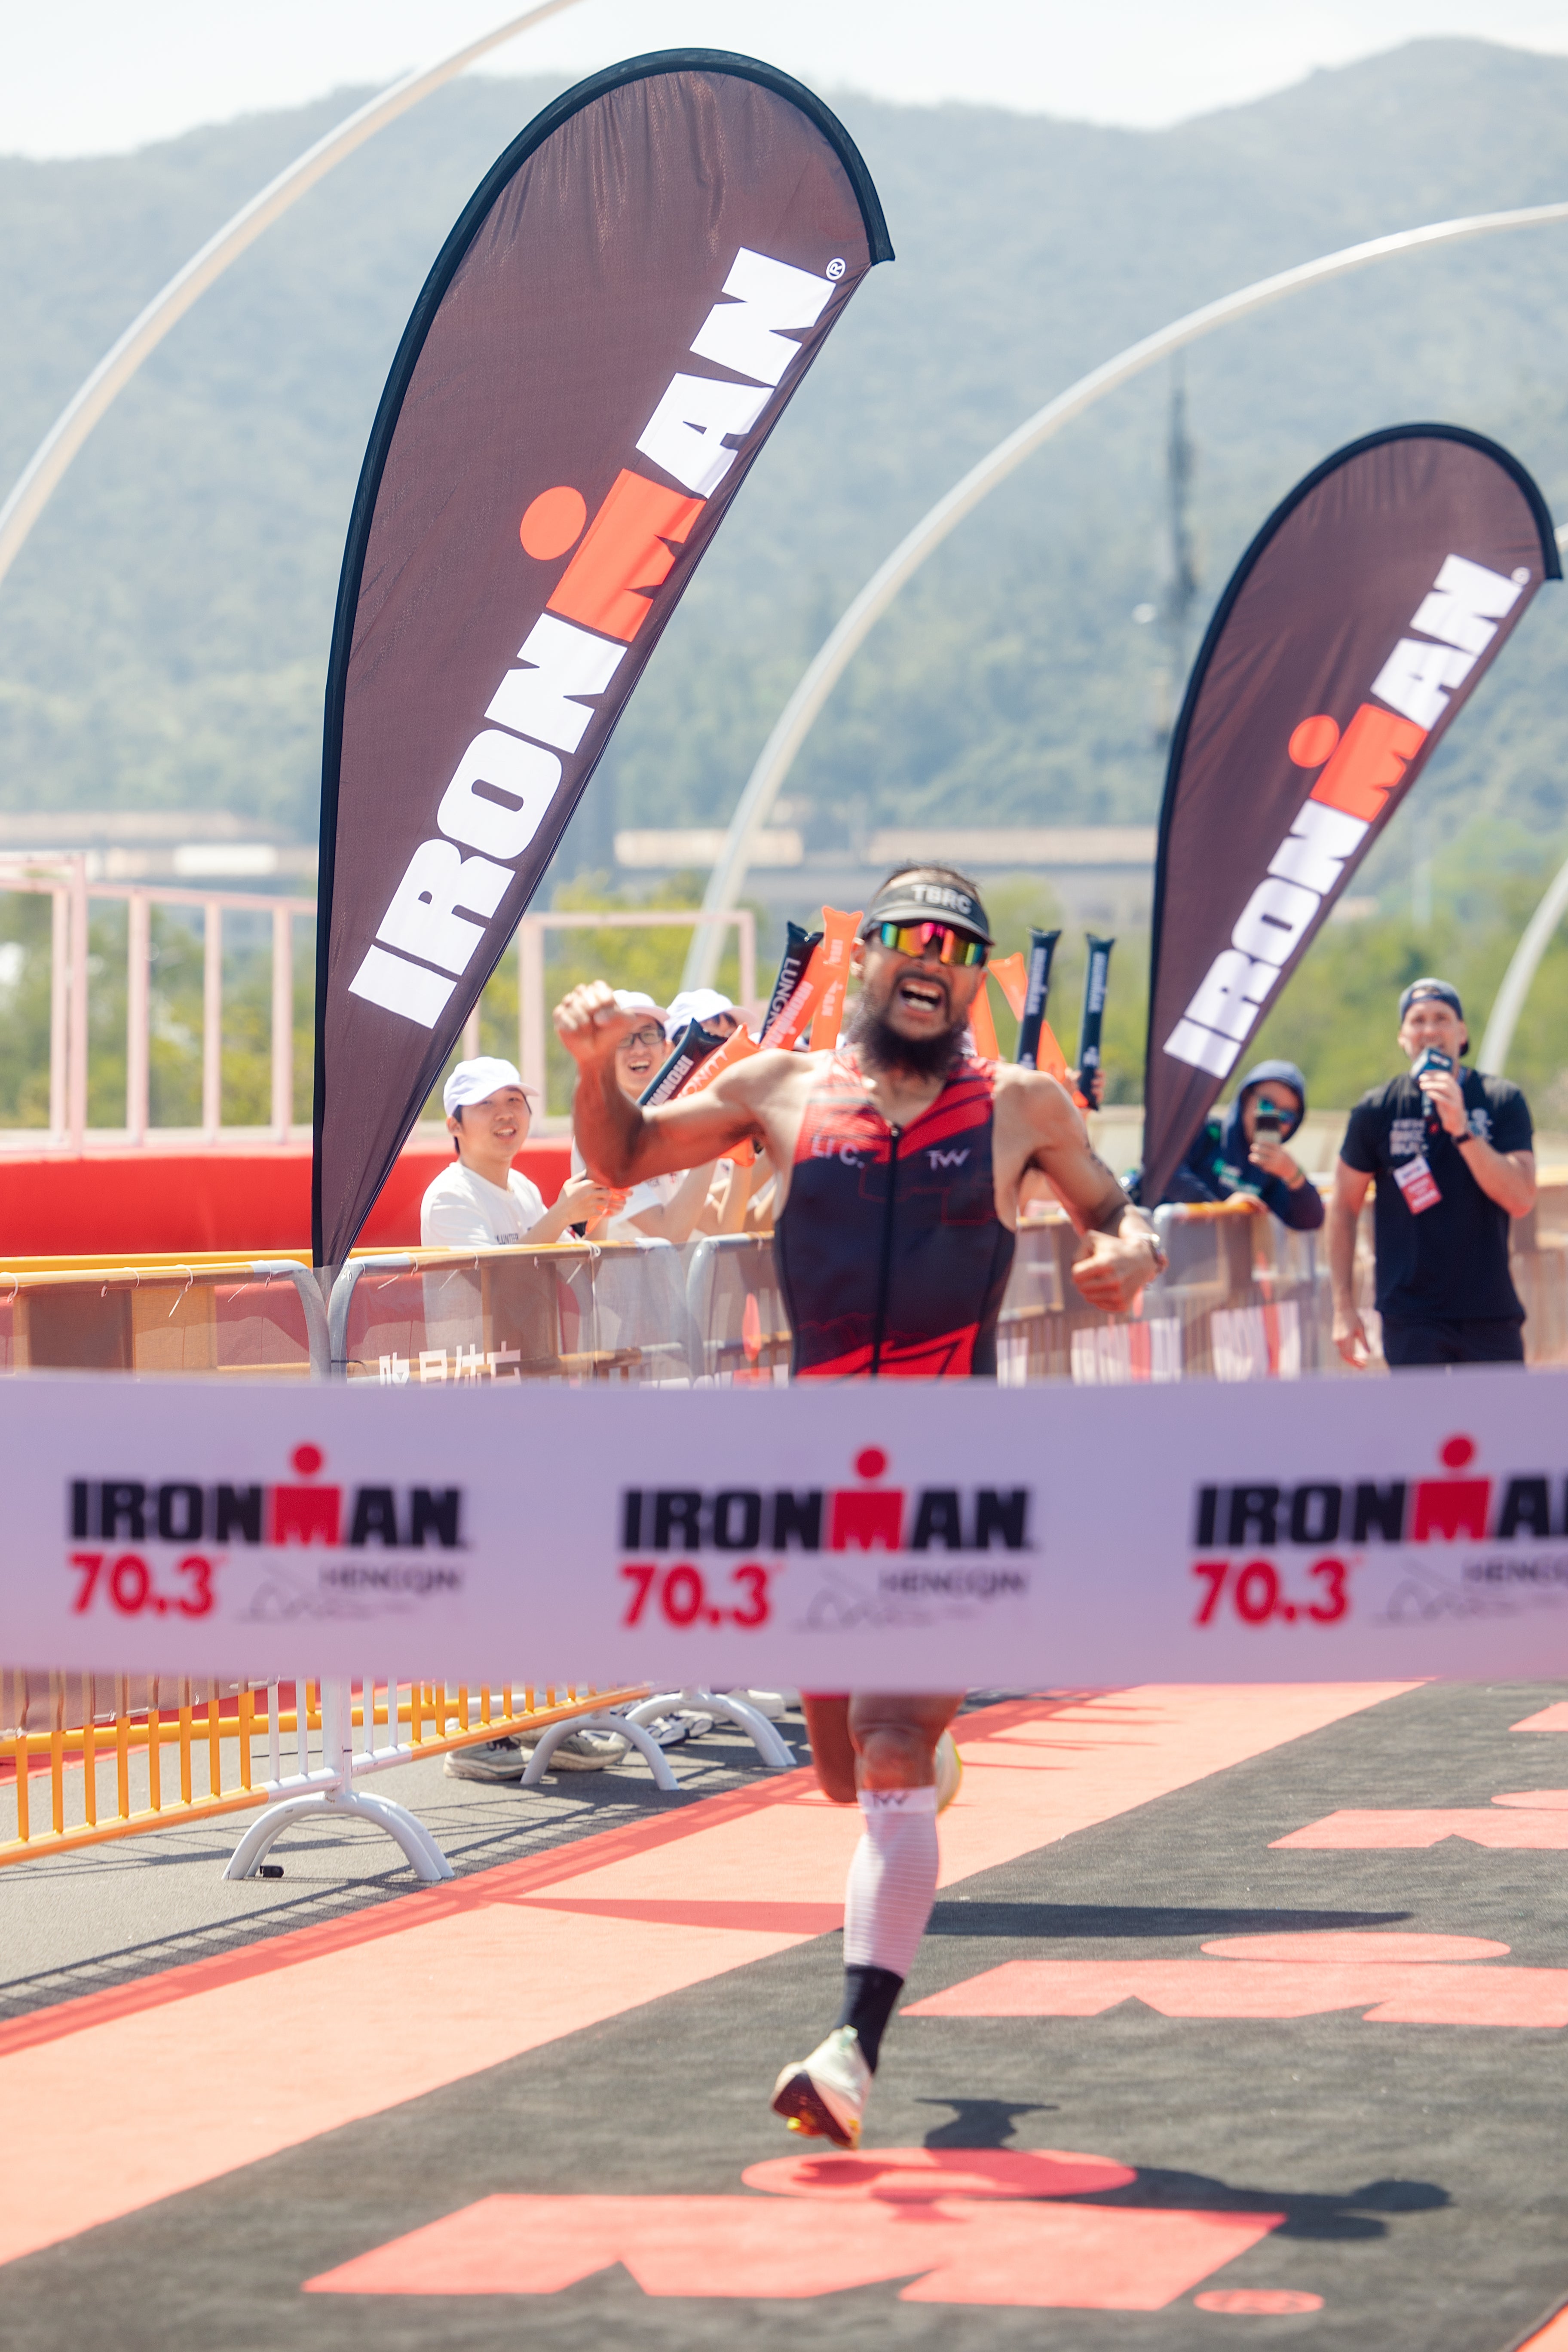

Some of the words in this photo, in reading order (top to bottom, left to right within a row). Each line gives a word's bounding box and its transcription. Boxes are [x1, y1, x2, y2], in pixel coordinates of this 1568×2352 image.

[348, 247, 836, 1029] IRONMAN
[1163, 554, 1524, 1079] IRONMAN
[70, 1442, 462, 1549] IRONMAN
[622, 1446, 1029, 1553] IRONMAN
[1195, 1435, 1568, 1549] IRONMA
[68, 1551, 216, 1620] 70.3
[619, 1562, 771, 1631] 70.3
[1192, 1556, 1351, 1628] 70.3
